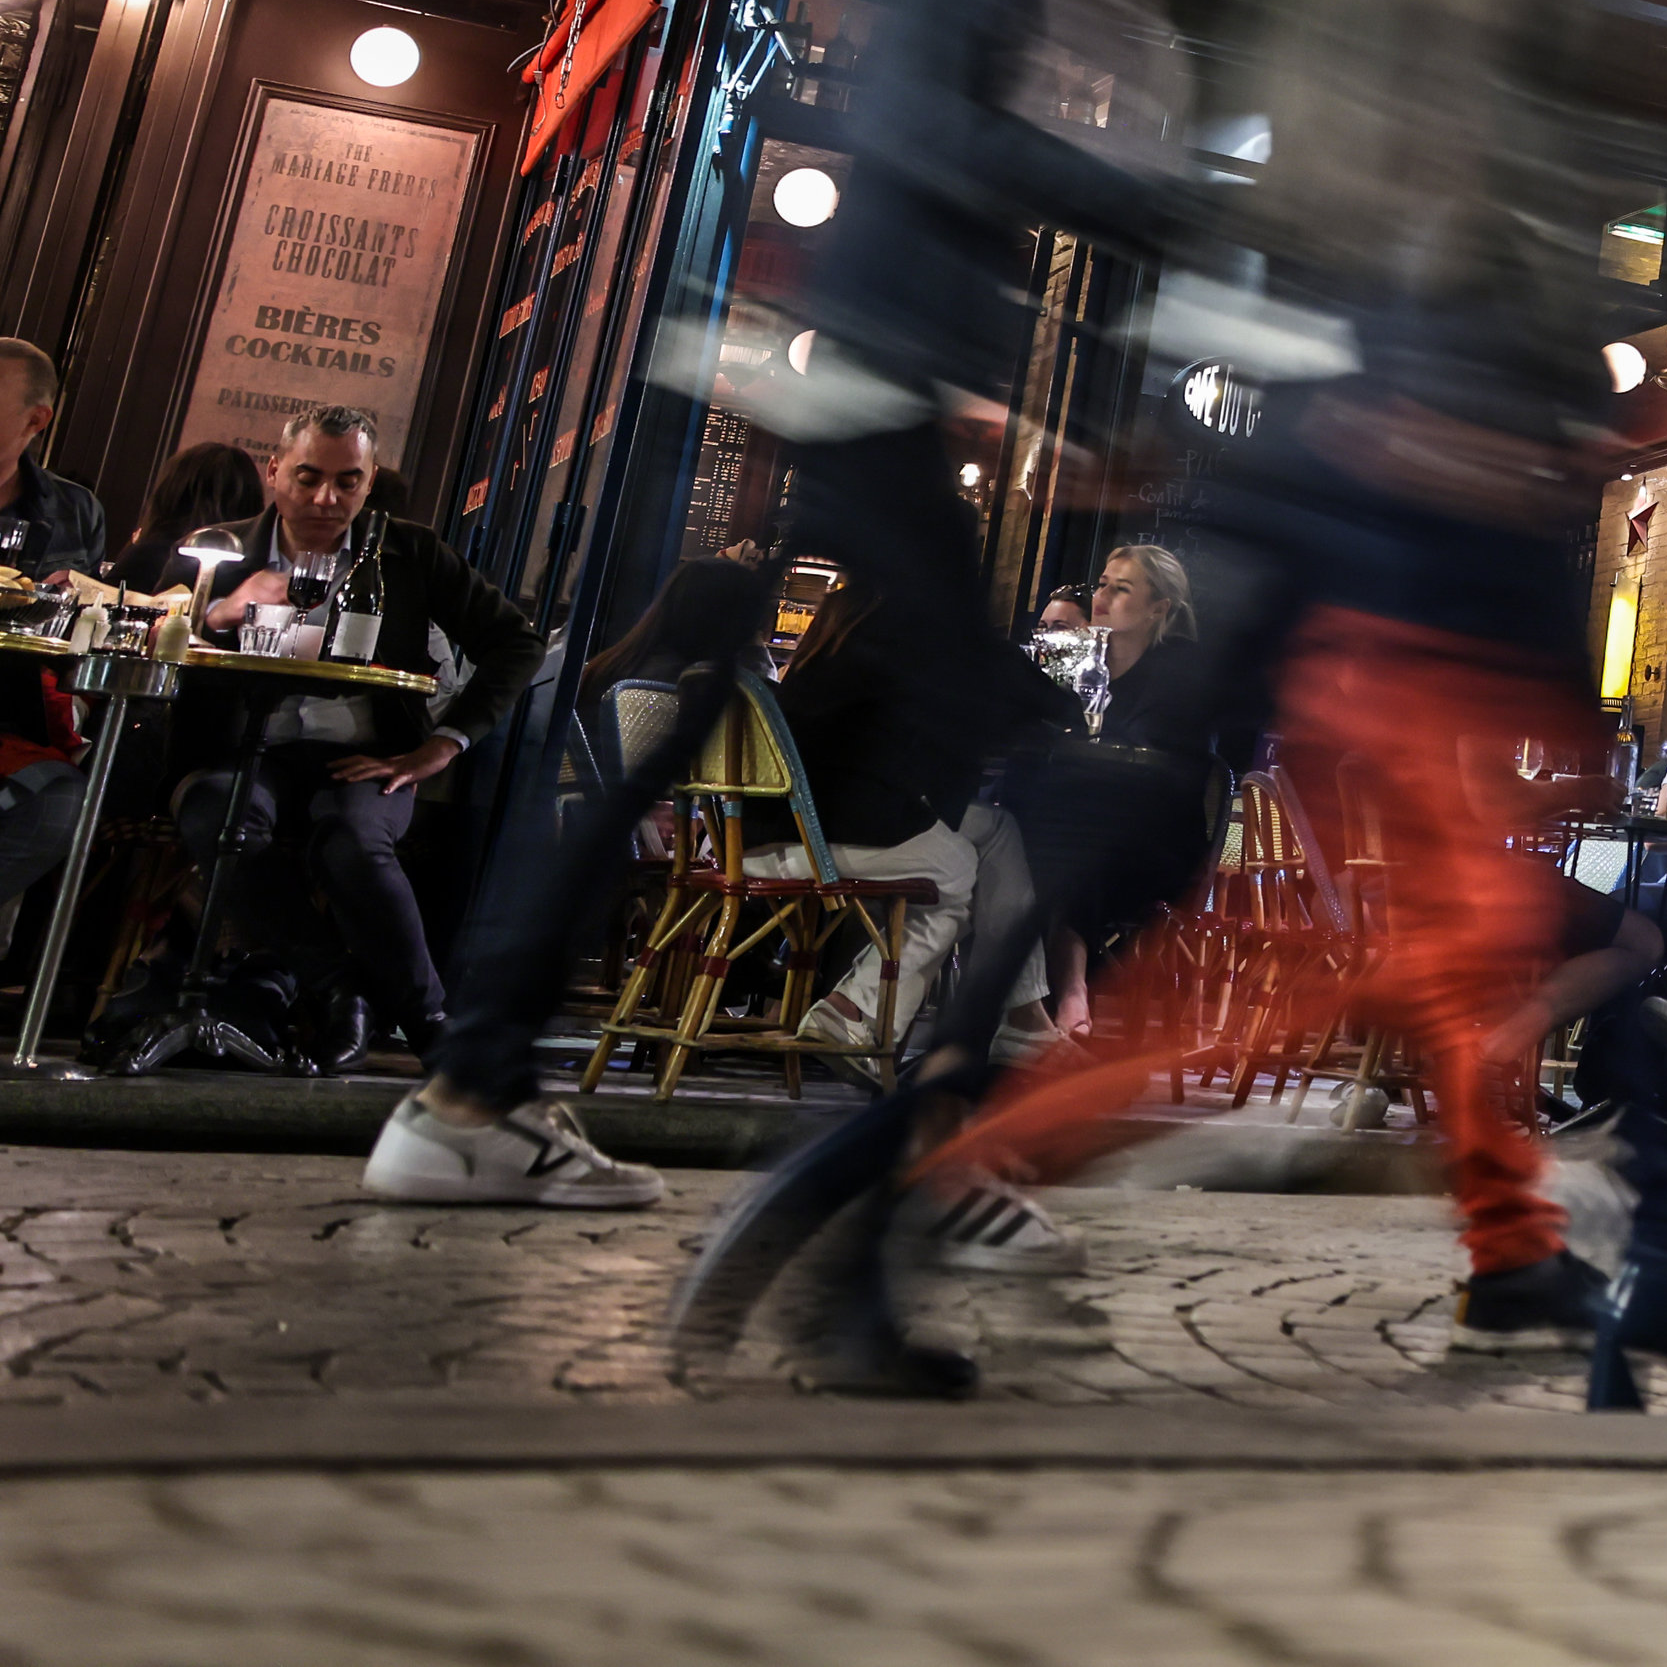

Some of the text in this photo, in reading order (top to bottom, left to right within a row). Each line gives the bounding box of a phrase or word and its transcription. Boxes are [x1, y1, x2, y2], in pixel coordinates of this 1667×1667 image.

[271, 152, 359, 187] MARIAGE
[264, 203, 420, 259] CROISSANTS
[272, 238, 397, 288] CHOCOLAT
[254, 304, 382, 346] BIÈRES
[225, 334, 396, 379] COCKTAILS
